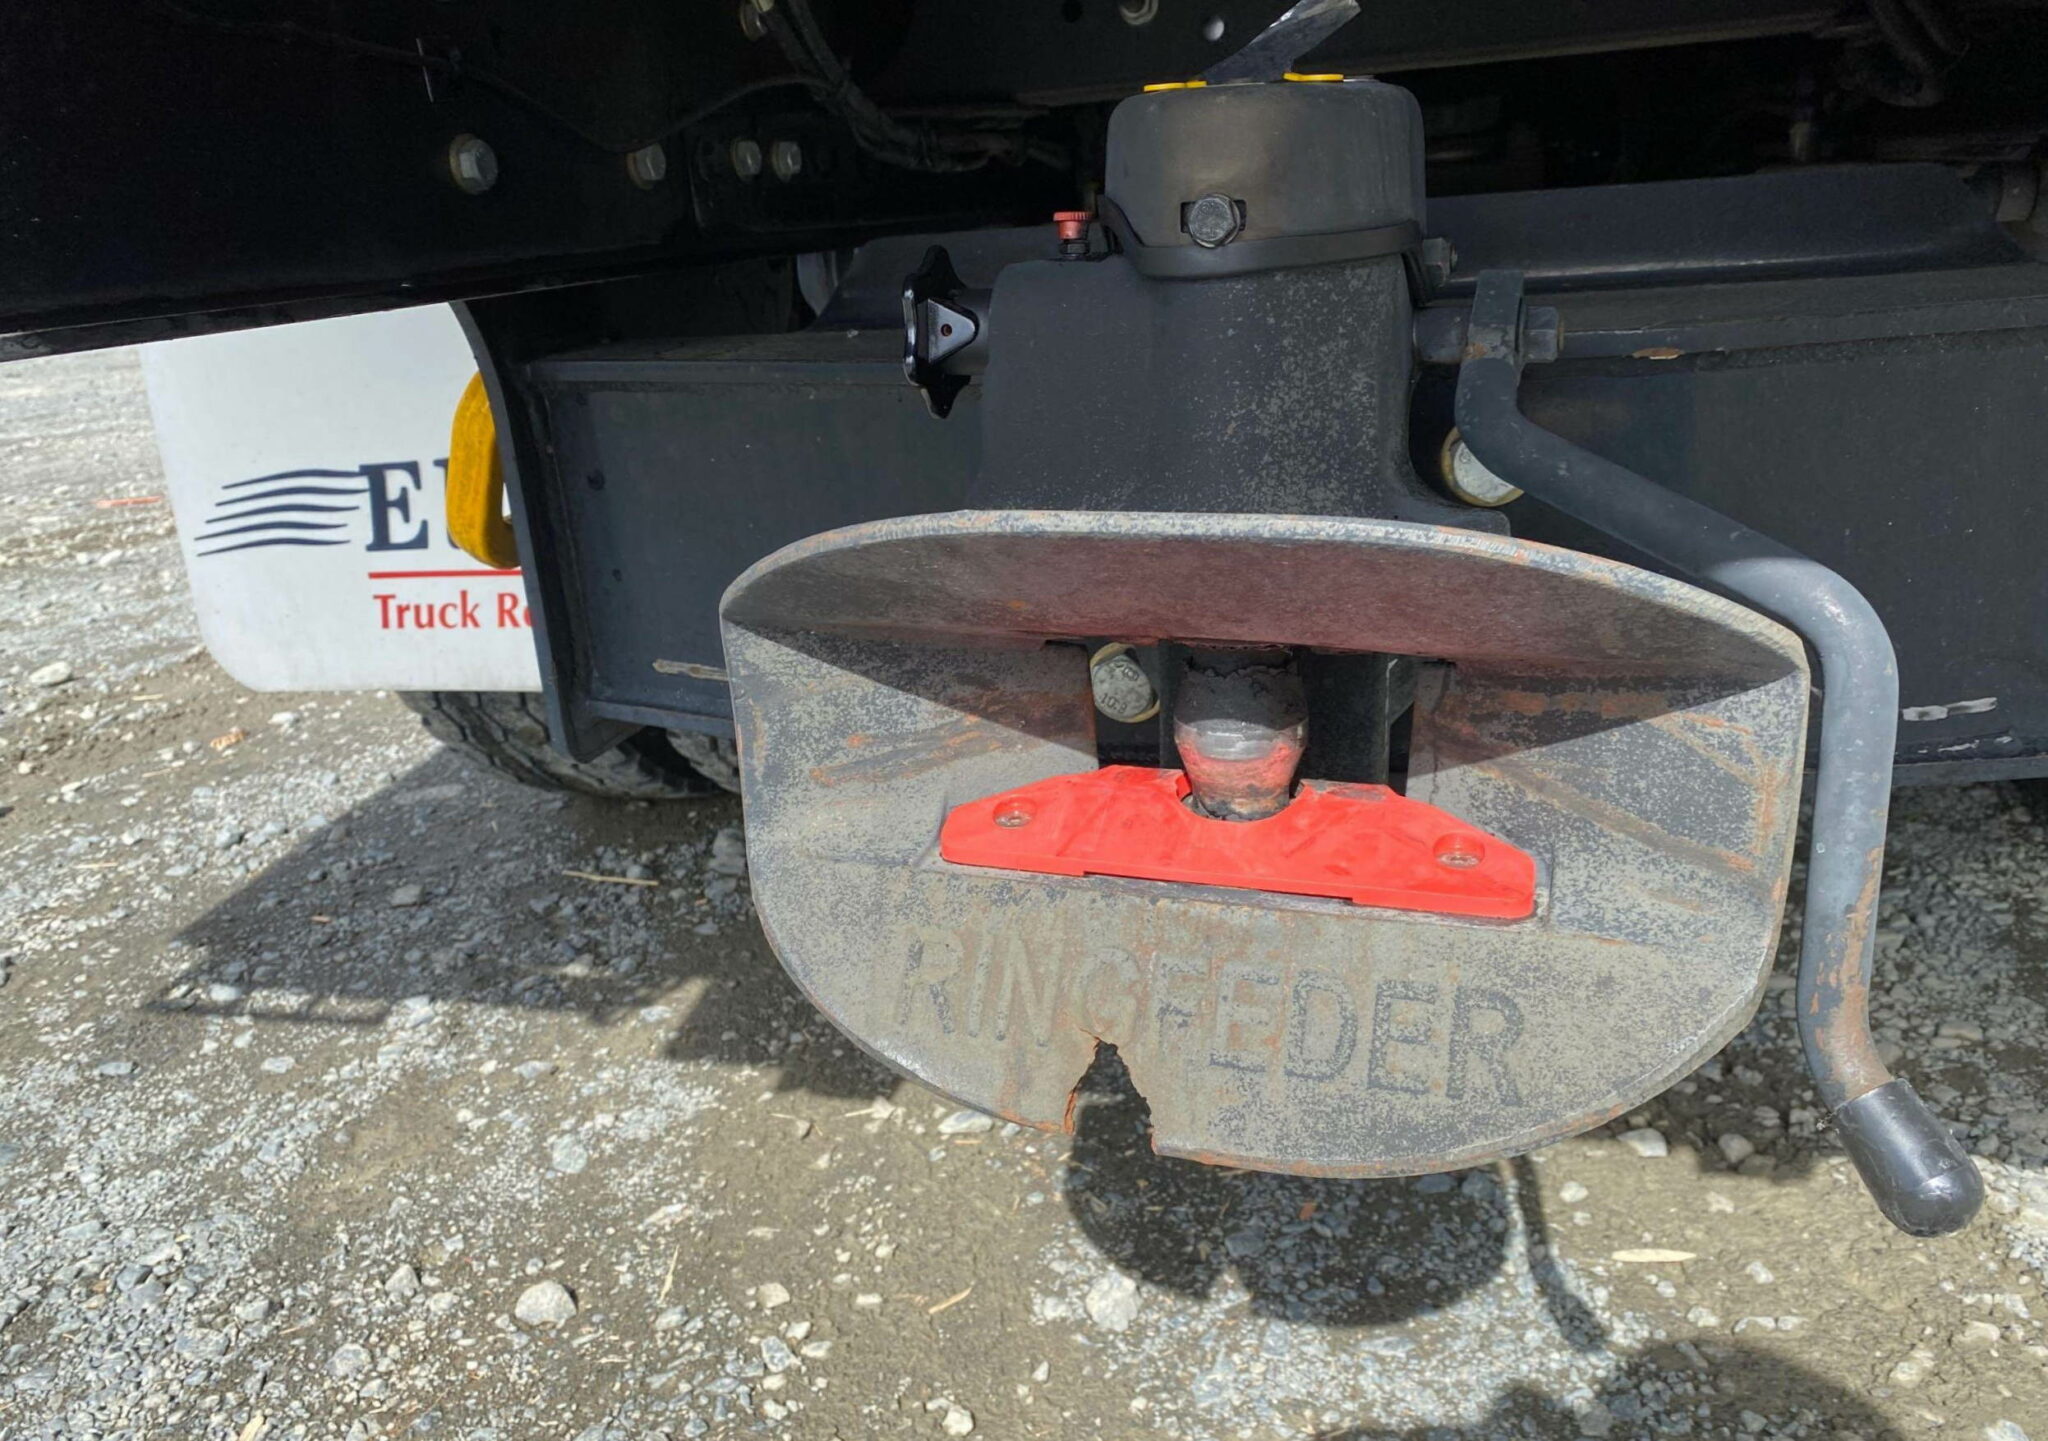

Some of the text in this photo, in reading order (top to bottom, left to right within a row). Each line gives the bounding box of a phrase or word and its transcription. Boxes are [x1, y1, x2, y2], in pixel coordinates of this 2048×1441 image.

[359, 458, 460, 551] E
[373, 589, 481, 629] Truck
[899, 924, 1525, 1106] RINGFEDER
